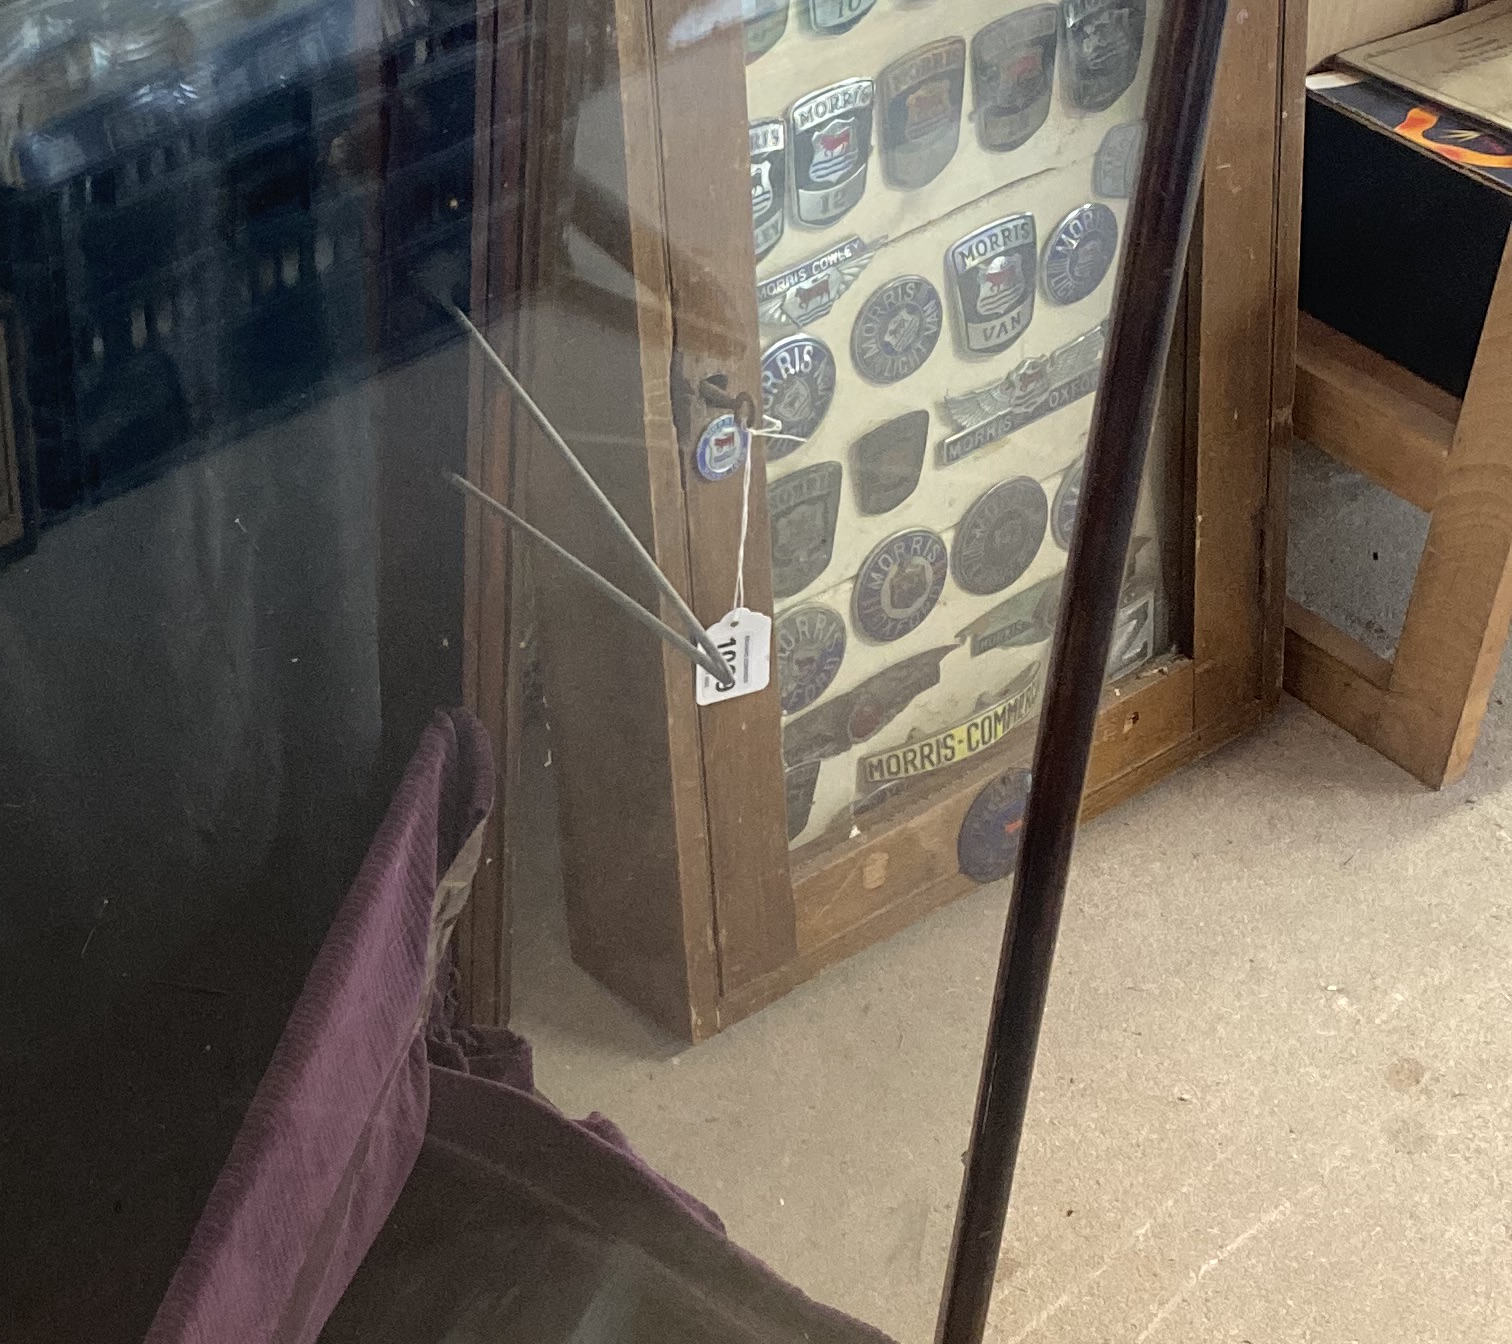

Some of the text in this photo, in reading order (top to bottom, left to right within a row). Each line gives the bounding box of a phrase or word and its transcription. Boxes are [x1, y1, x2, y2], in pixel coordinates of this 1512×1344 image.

[797, 84, 873, 128] MORRIS
[819, 193, 847, 215] 12
[957, 221, 1032, 270] MORRIS
[757, 241, 862, 301] MORRIS COWLEY
[860, 282, 916, 359] MORRIS
[922, 299, 941, 337] VAN
[982, 312, 1022, 343] VAN
[761, 344, 814, 408] ORRIS
[948, 416, 1013, 459] MORRIS
[867, 536, 941, 590] MORRIS
[777, 613, 842, 656] ORRIS
